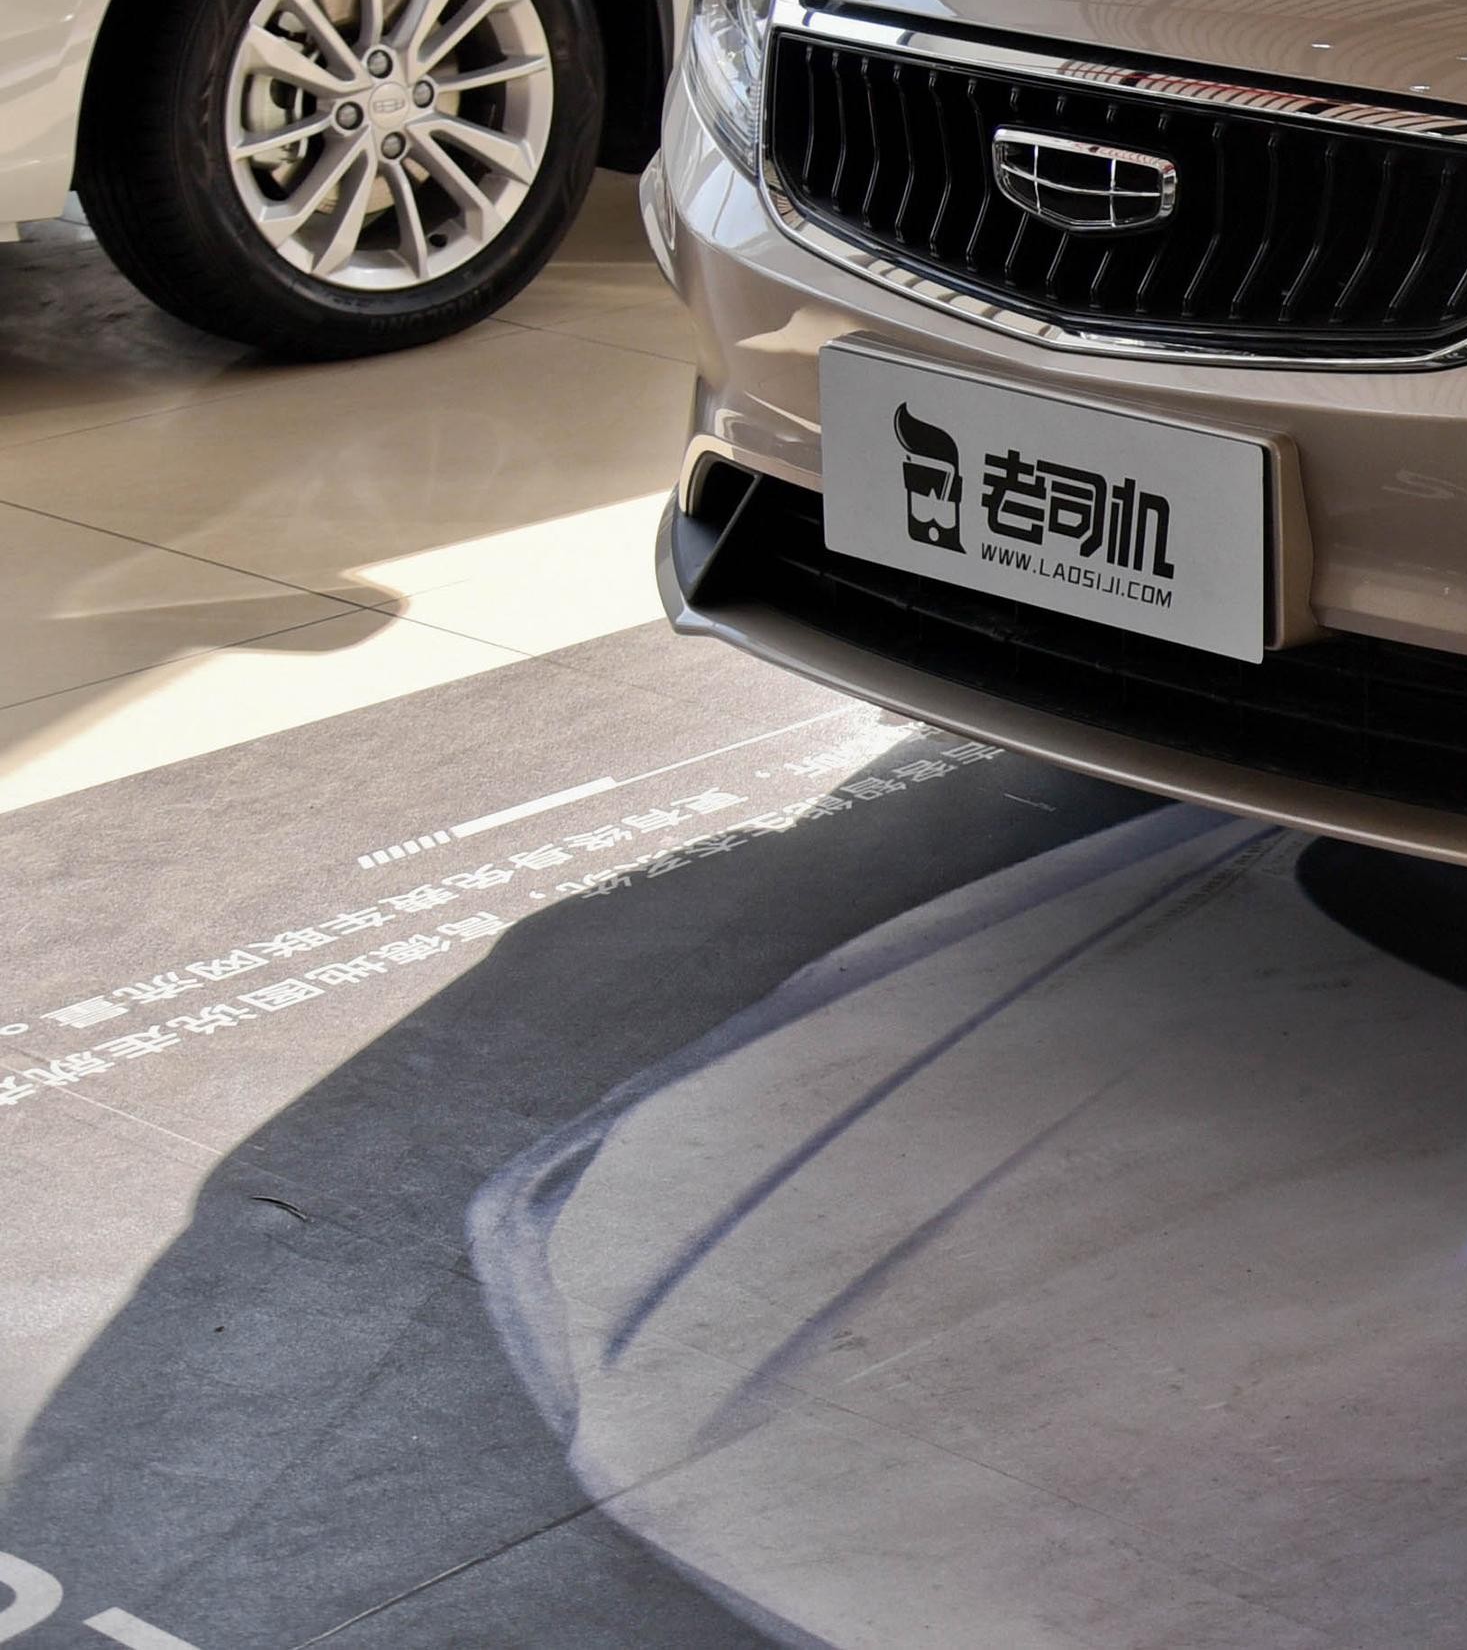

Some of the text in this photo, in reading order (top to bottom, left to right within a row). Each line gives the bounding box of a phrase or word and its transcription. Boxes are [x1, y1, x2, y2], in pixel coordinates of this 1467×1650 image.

[981, 449, 1175, 579] 老司机
[980, 541, 1173, 610] WWW.LAOSIJI.COM
